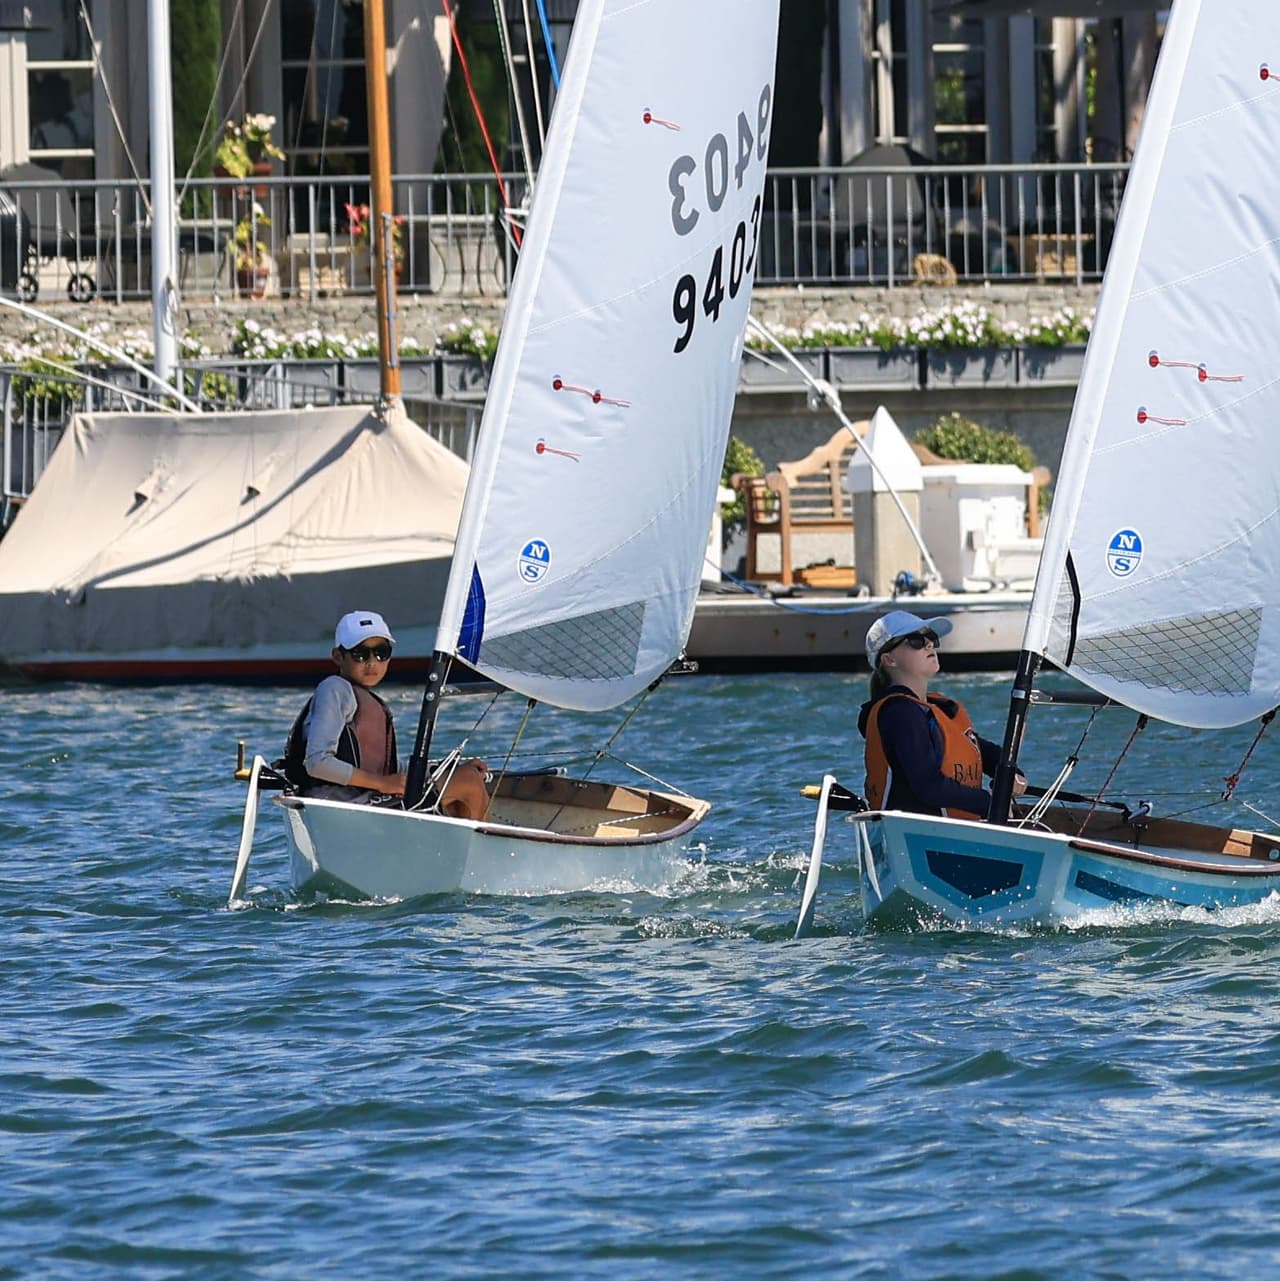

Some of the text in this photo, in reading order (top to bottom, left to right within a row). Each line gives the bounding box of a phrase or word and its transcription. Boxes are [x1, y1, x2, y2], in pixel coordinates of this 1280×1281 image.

[672, 194, 761, 354] 9403
[1117, 533, 1137, 550] N
[1113, 557, 1131, 572] S
